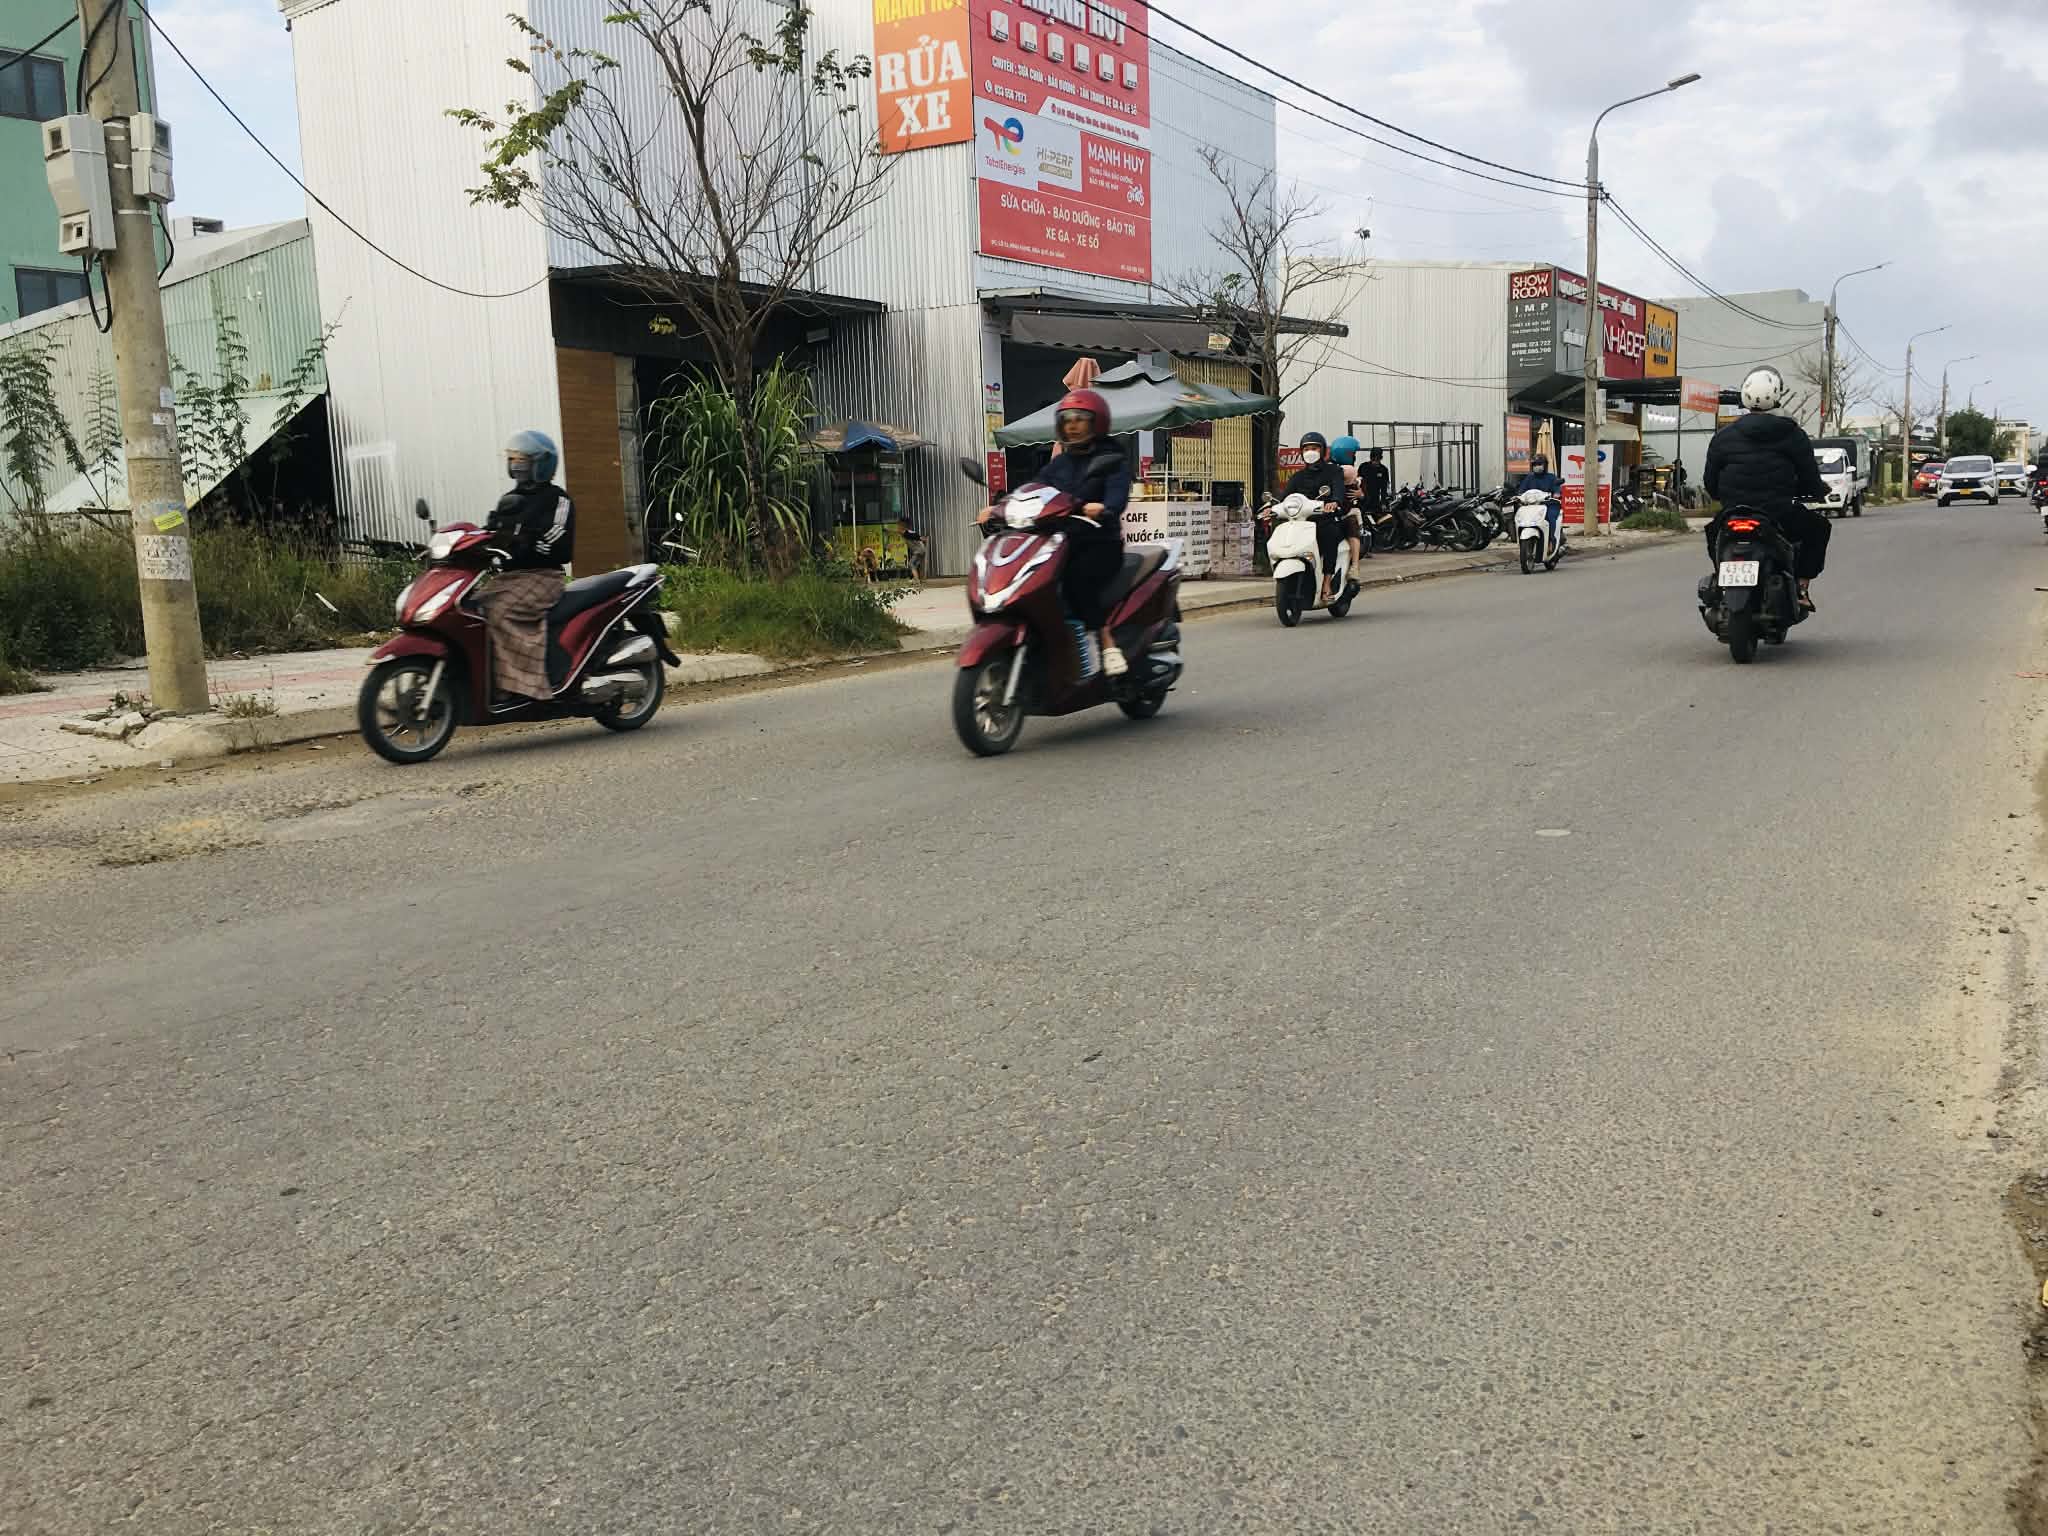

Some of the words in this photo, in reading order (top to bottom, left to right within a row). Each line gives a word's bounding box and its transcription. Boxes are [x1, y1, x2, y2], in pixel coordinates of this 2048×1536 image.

[877, 34, 968, 94] RỬA
[895, 89, 952, 137] XE
[1088, 141, 1121, 168] MẠNH
[1123, 152, 1145, 176] HUY
[1000, 191, 1019, 209] SỬA
[1021, 197, 1046, 216] CHỮA
[1052, 204, 1070, 222] BẢO
[1072, 209, 1101, 228] DƯỠNG
[1106, 217, 1122, 234] BẢO
[1045, 227, 1056, 240] XE
[1058, 230, 1070, 243] GA
[1077, 234, 1087, 247] XE
[1088, 234, 1099, 249] SỐ
[1513, 272, 1548, 288] SHOW
[1512, 285, 1548, 300] ROOM
[1126, 512, 1148, 523] CAFE
[1126, 529, 1153, 543] NƯỚC
